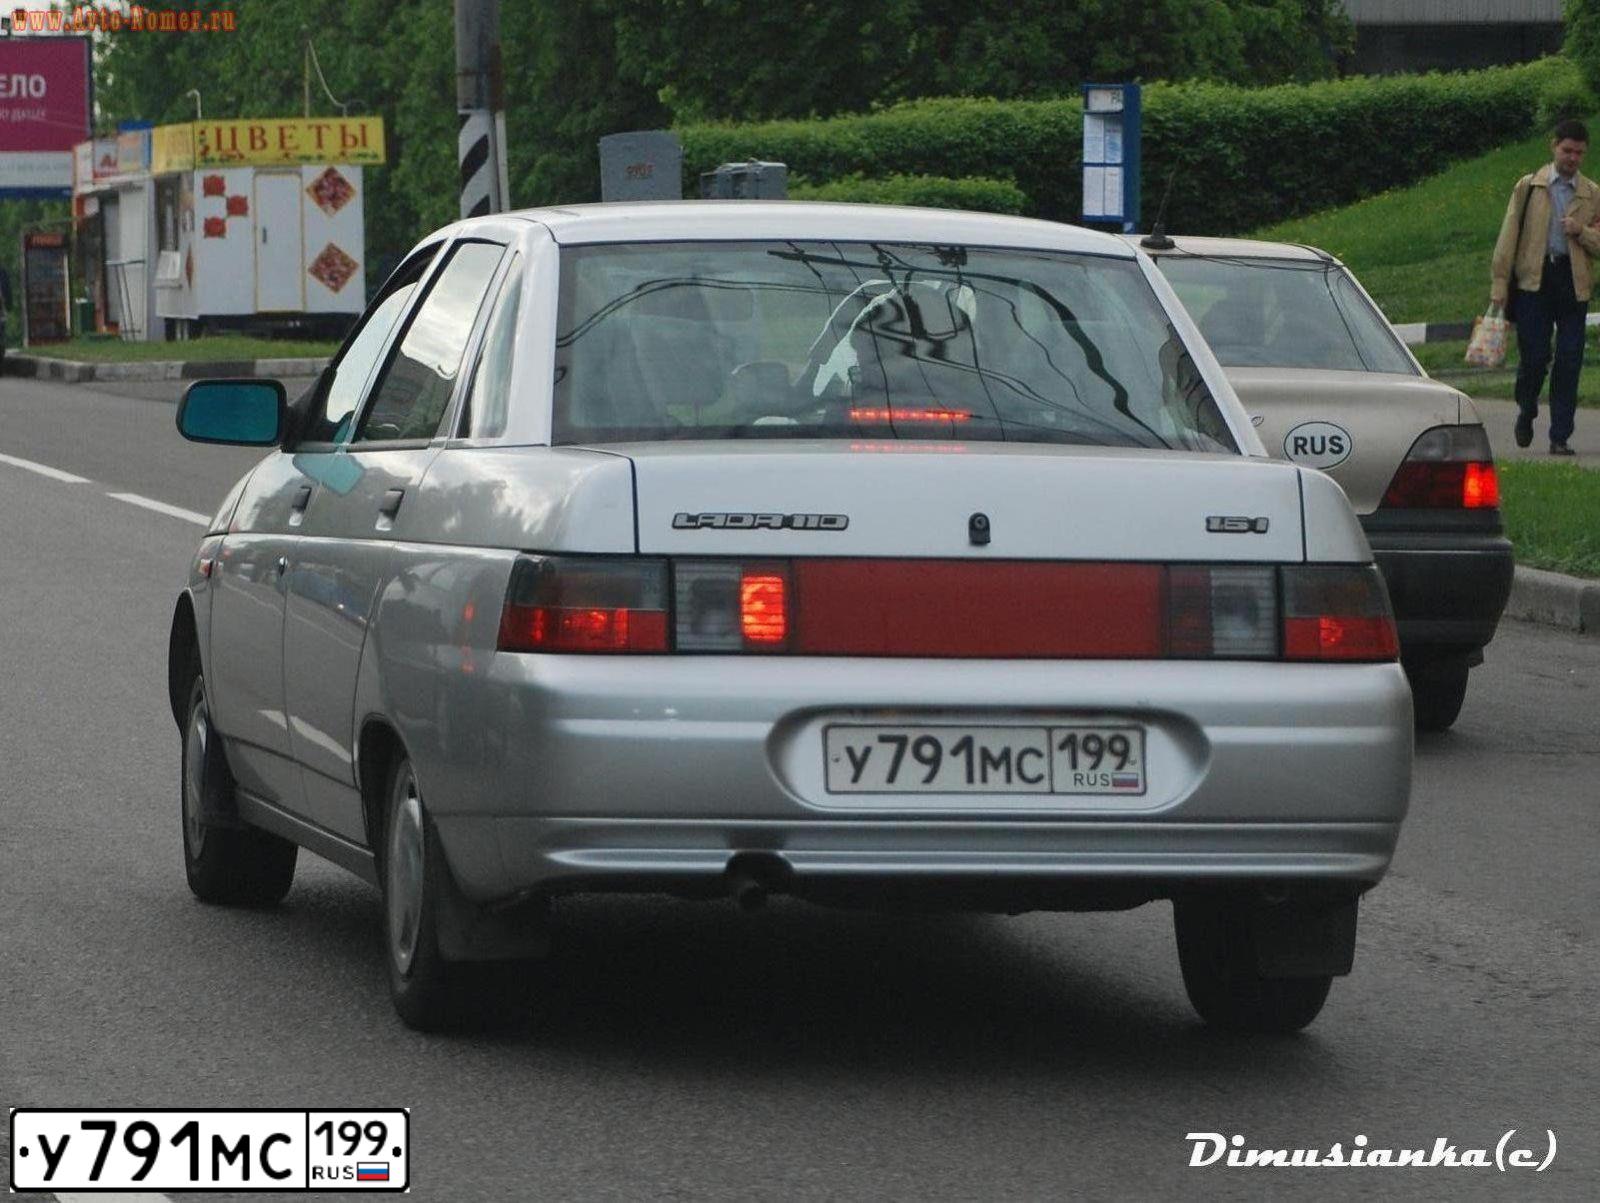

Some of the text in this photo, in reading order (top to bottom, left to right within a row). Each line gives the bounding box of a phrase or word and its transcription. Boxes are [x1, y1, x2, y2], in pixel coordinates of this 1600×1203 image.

[215, 123, 368, 156] ЦВЕТЫ
[1293, 435, 1345, 456] RUS
[672, 512, 784, 530] LADA
[1058, 732, 1131, 771] 199
[1073, 772, 1110, 787] RUS
